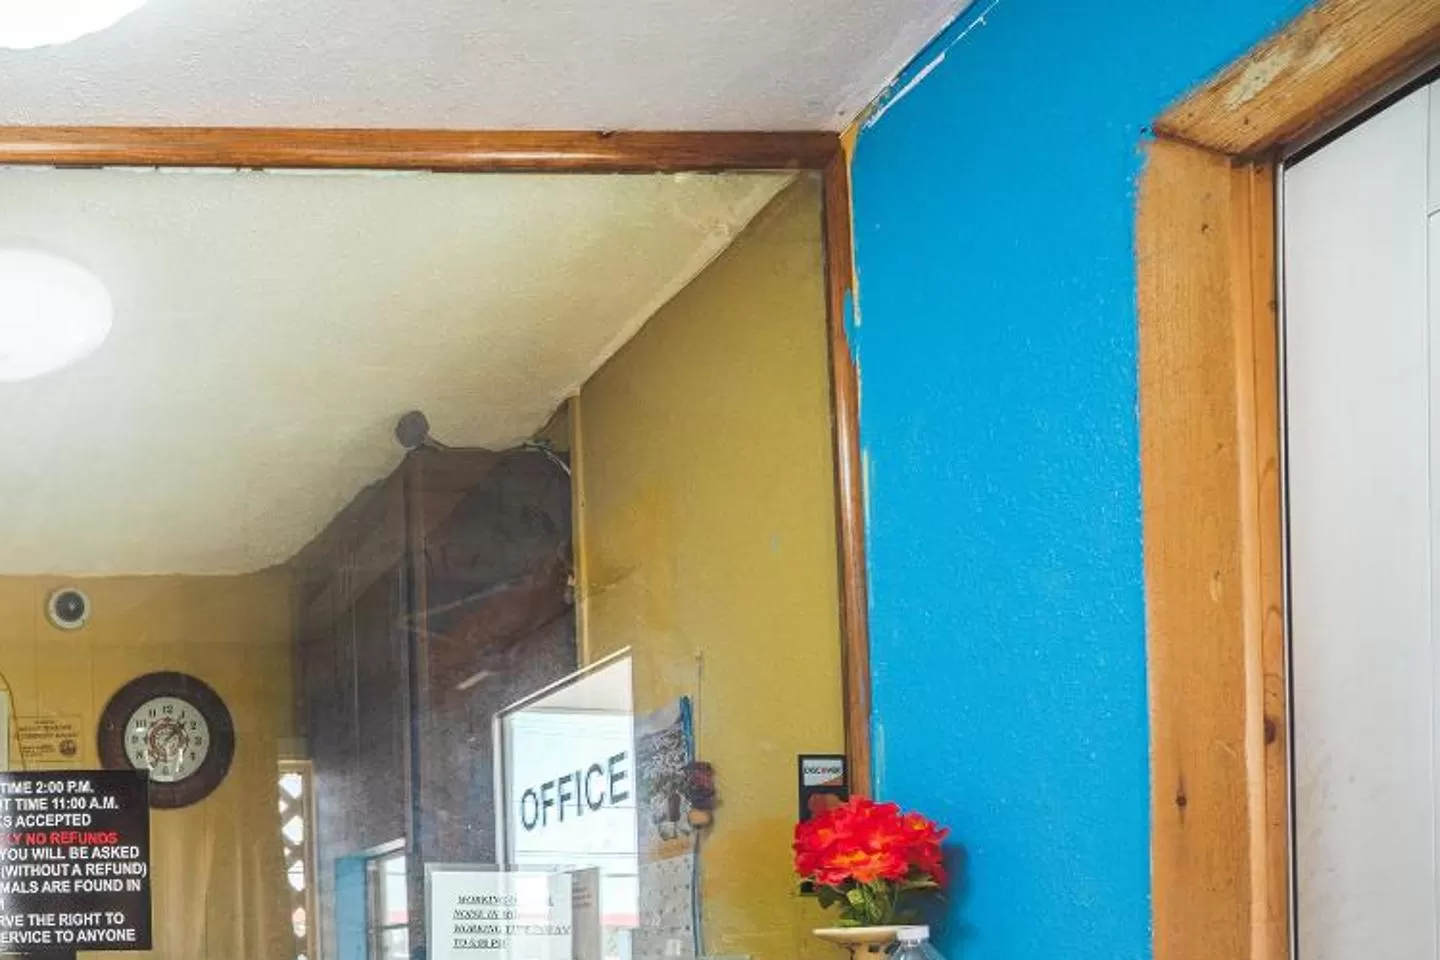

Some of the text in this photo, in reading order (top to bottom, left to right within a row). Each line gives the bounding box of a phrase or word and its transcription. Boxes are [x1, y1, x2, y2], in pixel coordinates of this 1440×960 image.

[162, 704, 174, 714] 12
[0, 781, 33, 794] TIME
[35, 781, 65, 794] 2:00
[67, 780, 95, 793] P.M.
[521, 750, 630, 831] OFFICE
[15, 798, 48, 811] TIME
[52, 797, 87, 810] 11:00
[89, 796, 119, 809] A.M.
[15, 813, 92, 827] ACCEPTED
[26, 832, 47, 845] NO
[50, 831, 119, 845] REFUNDS
[0, 848, 28, 861] YOU
[32, 847, 66, 860] WILL
[69, 846, 89, 859] BE
[91, 846, 140, 859] ASKED
[1, 863, 70, 878] (WITHOUT
[71, 863, 82, 876] A
[85, 862, 147, 878] REFUND)
[41, 880, 71, 893] ARE
[74, 879, 124, 892] FOUND
[126, 878, 142, 892] IN
[27, 913, 56, 926] THE
[59, 912, 102, 926] RIGHT
[104, 911, 125, 925] TO
[55, 930, 74, 943] TO
[77, 928, 136, 943] ANYONE
